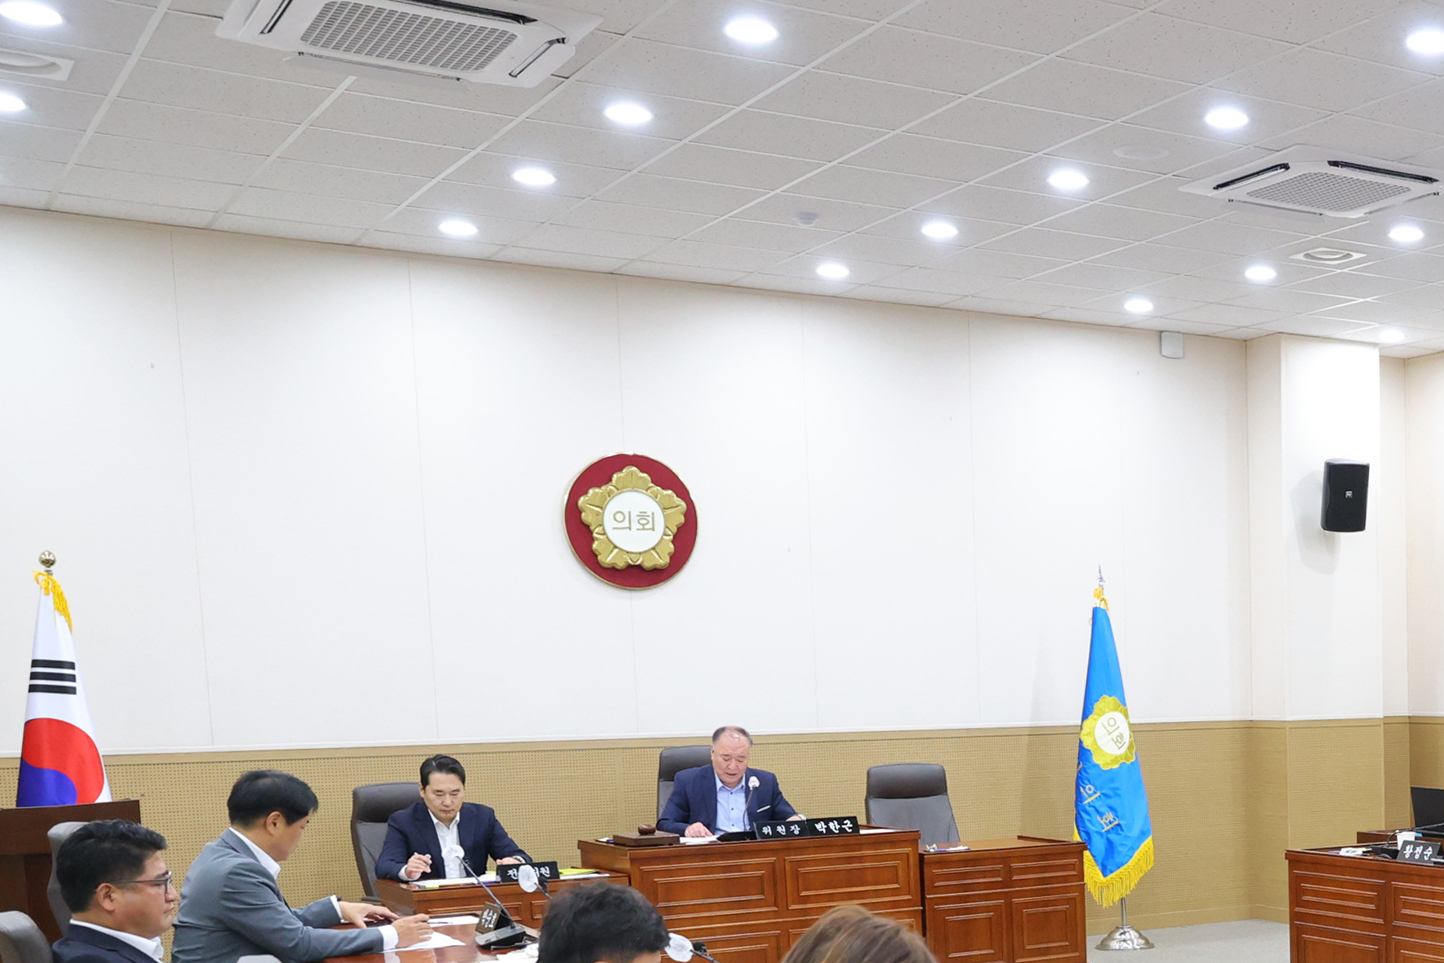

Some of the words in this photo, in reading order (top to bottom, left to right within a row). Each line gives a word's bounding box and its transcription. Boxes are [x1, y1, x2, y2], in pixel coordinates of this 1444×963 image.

[612, 510, 655, 532] 의회
[1101, 717, 1126, 750] 의회
[762, 825, 800, 836] 위원장
[814, 820, 853, 834] 박한근
